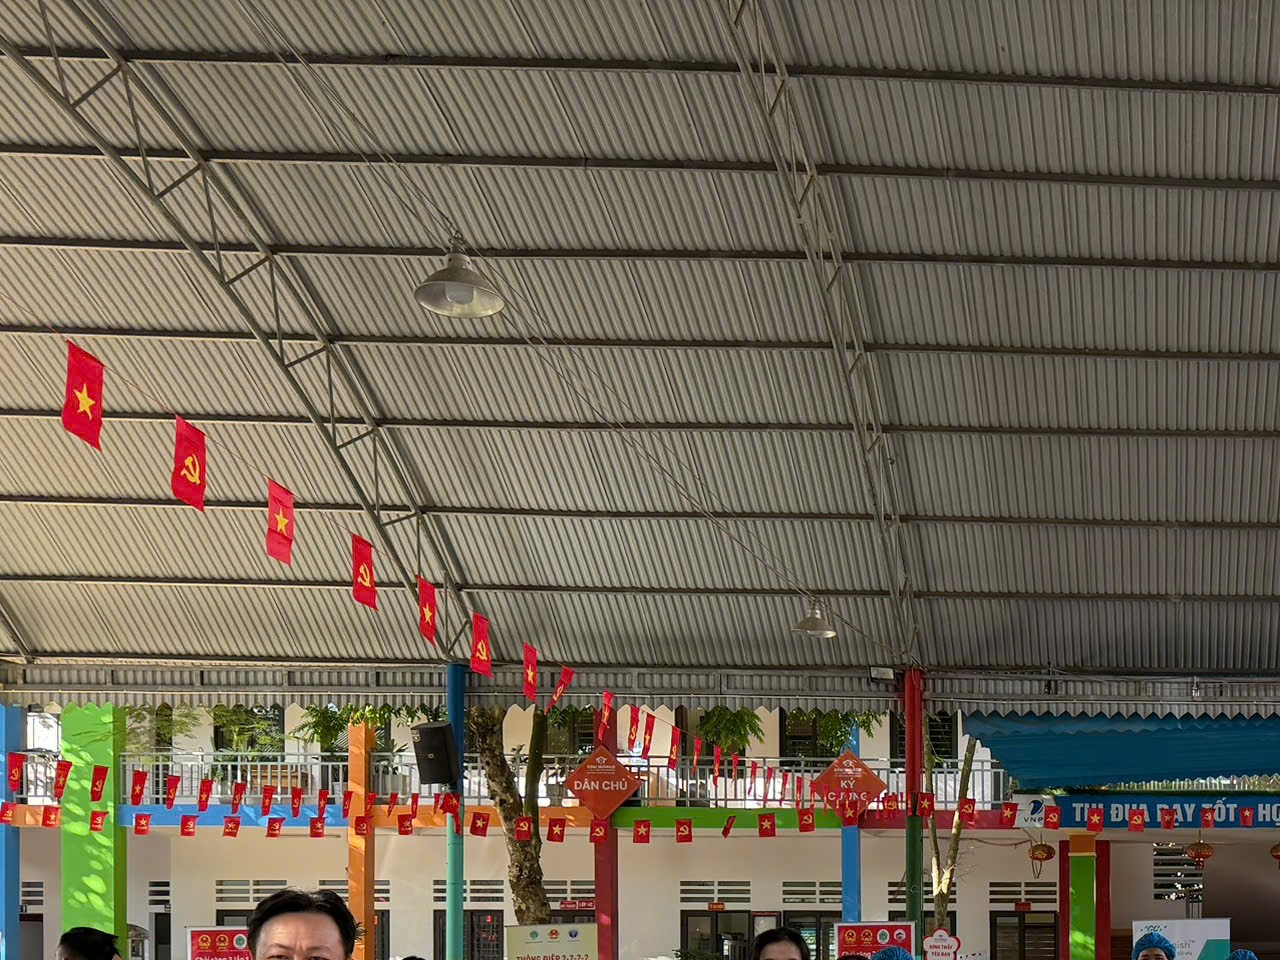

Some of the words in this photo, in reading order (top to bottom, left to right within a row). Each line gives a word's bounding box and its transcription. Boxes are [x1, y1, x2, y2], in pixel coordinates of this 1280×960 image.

[575, 778, 599, 790] DÂN
[602, 778, 628, 790] CHỦ
[841, 778, 855, 788] KỶ
